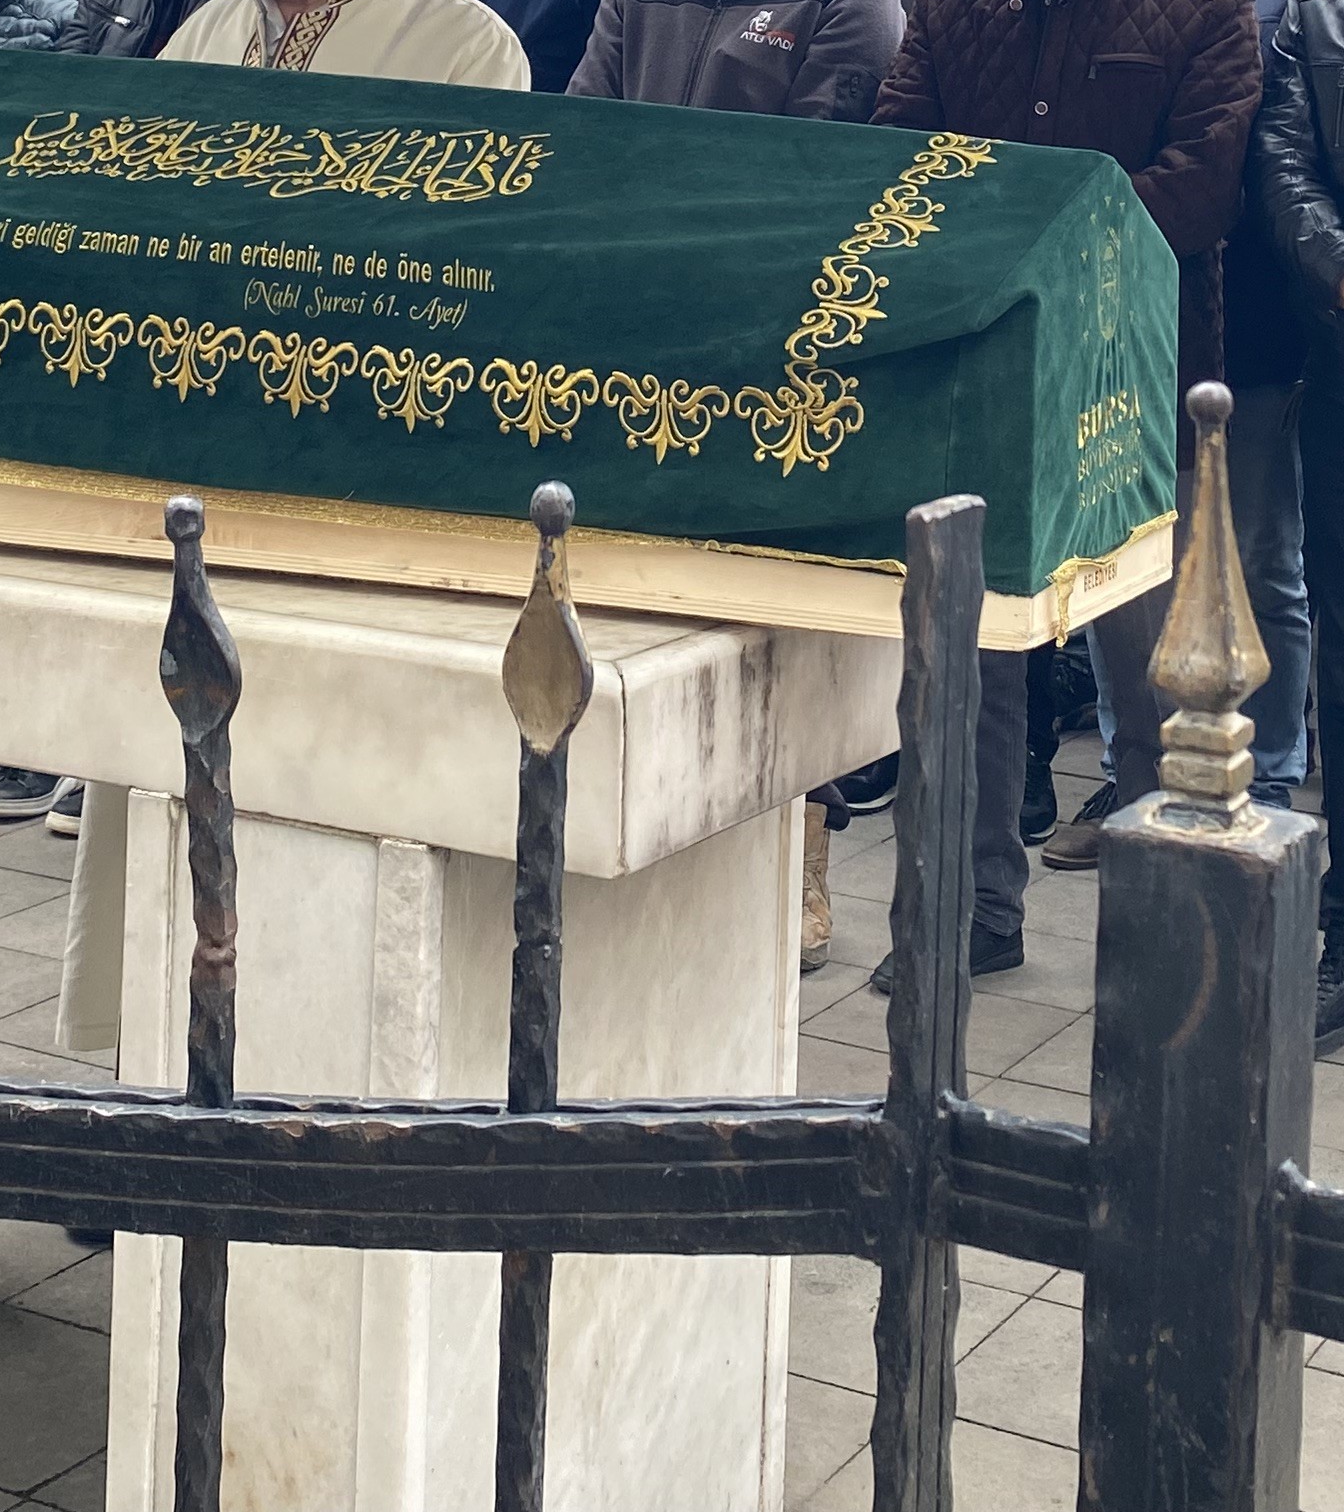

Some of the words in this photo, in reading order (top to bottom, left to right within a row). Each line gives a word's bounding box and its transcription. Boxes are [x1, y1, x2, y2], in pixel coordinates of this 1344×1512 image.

[12, 220, 78, 254] geldiği
[79, 231, 140, 256] zaman
[147, 236, 170, 259] ne
[176, 233, 203, 262] bir
[209, 242, 232, 265] an
[241, 241, 323, 278] ertelenir,
[332, 252, 356, 276] ne
[364, 250, 387, 279] de
[397, 252, 433, 283] öne
[442, 258, 495, 292] alınır.
[244, 277, 302, 316] (Nahl
[372, 292, 400, 317] 61.
[409, 296, 468, 331] Ayet)
